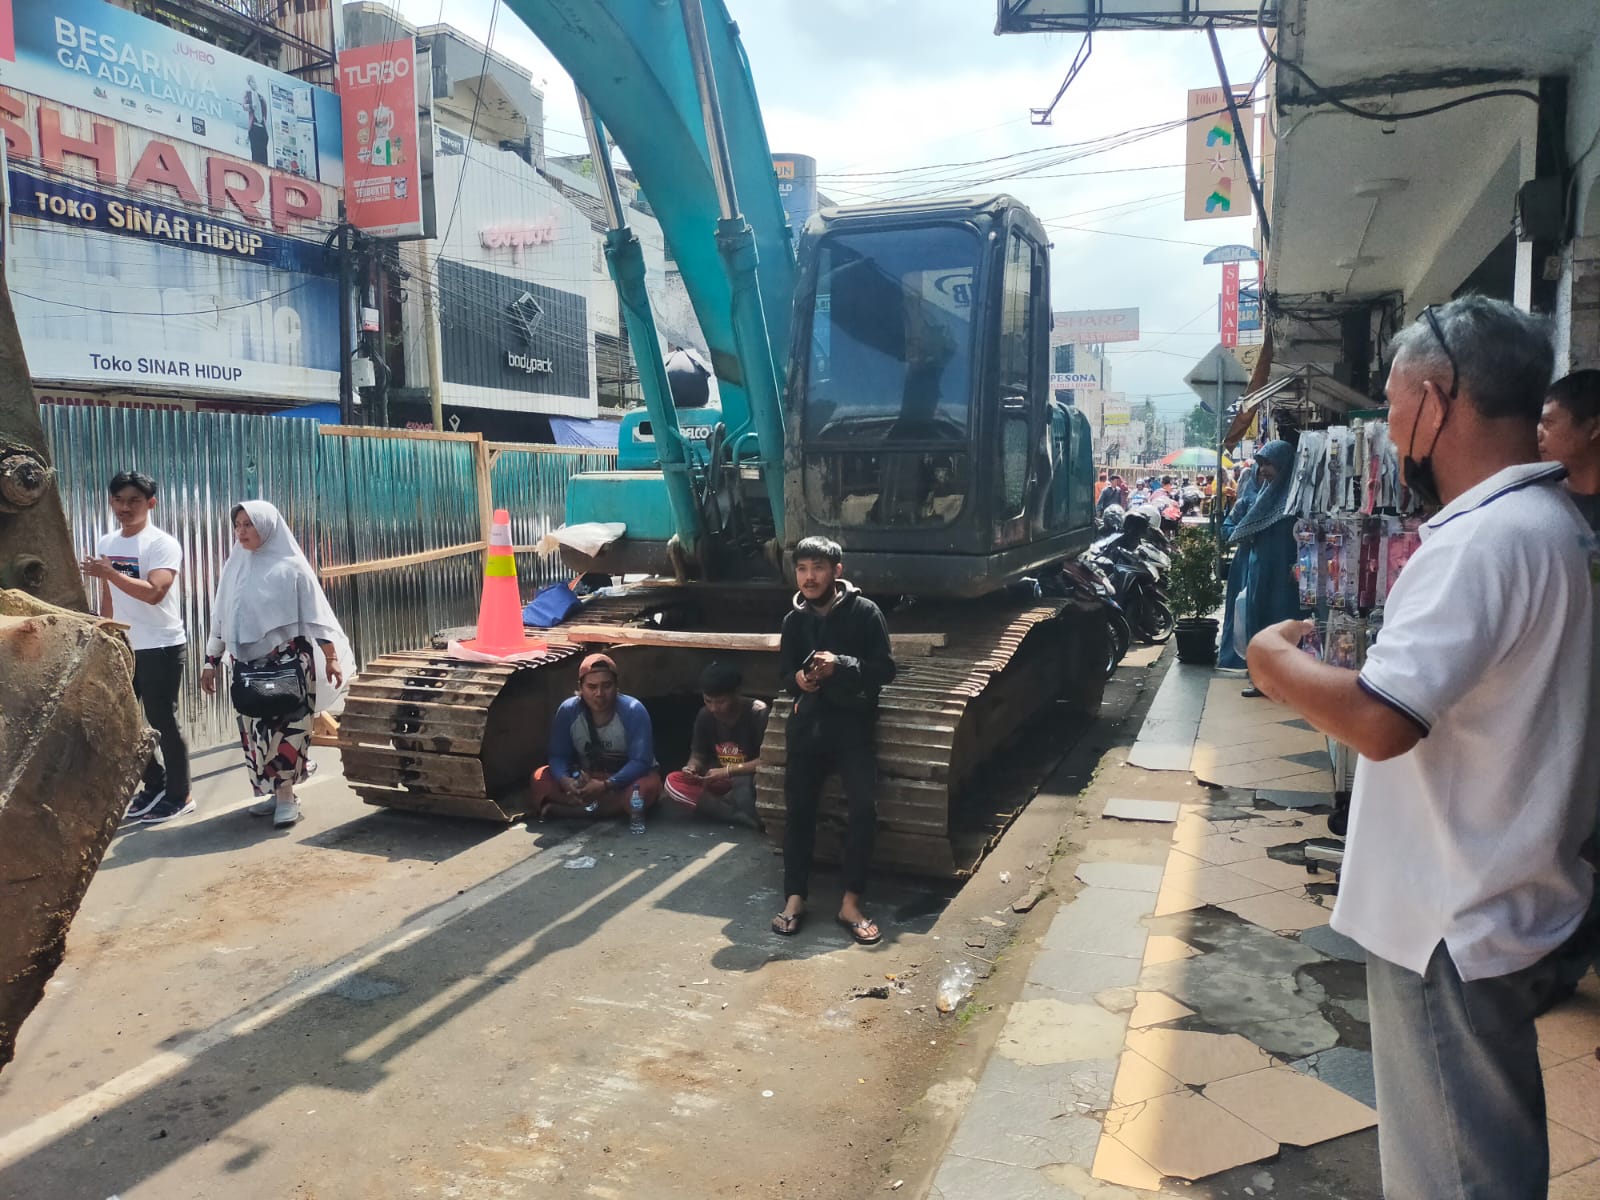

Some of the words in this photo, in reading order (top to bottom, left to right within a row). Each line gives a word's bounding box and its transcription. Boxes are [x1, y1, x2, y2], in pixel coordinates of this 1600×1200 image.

[54, 16, 220, 98] BESARNYA
[174, 42, 215, 65] JUMBO
[57, 47, 92, 75] GA
[97, 62, 146, 93] ADA
[151, 78, 224, 119] LAWAN
[343, 57, 410, 86] TURBO
[0, 87, 323, 233] SHARP
[34, 191, 97, 222] TOKO
[107, 201, 191, 244] SINAR
[195, 222, 263, 257] HIDUP
[1055, 314, 1126, 328] SHARP
[1224, 268, 1237, 344] SUMAT
[89, 353, 133, 373] Toko
[137, 357, 191, 378] SINAR
[194, 363, 244, 383] HIDUP
[507, 351, 554, 374] bodypack
[1050, 373, 1097, 382] PESONA
